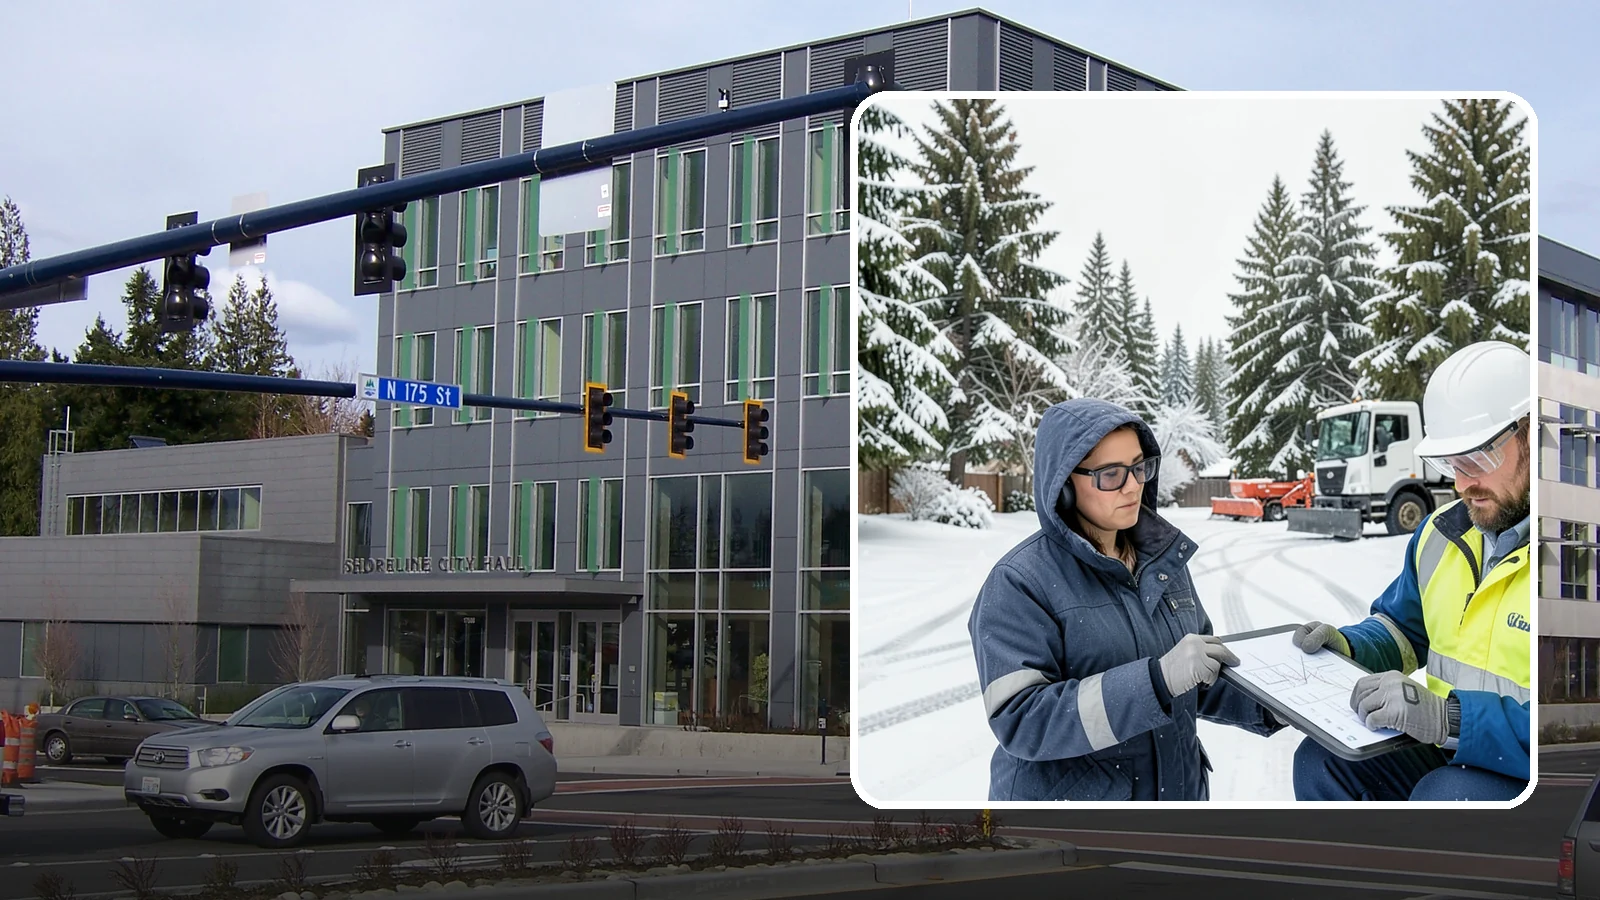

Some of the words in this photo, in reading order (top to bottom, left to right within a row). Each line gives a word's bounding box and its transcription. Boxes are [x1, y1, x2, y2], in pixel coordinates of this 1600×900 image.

[387, 380, 396, 400] N
[405, 382, 427, 403] 175
[436, 386, 451, 406] St
[344, 557, 431, 574] SHORELINE
[438, 556, 475, 573] CITY
[484, 555, 525, 572] HALL
